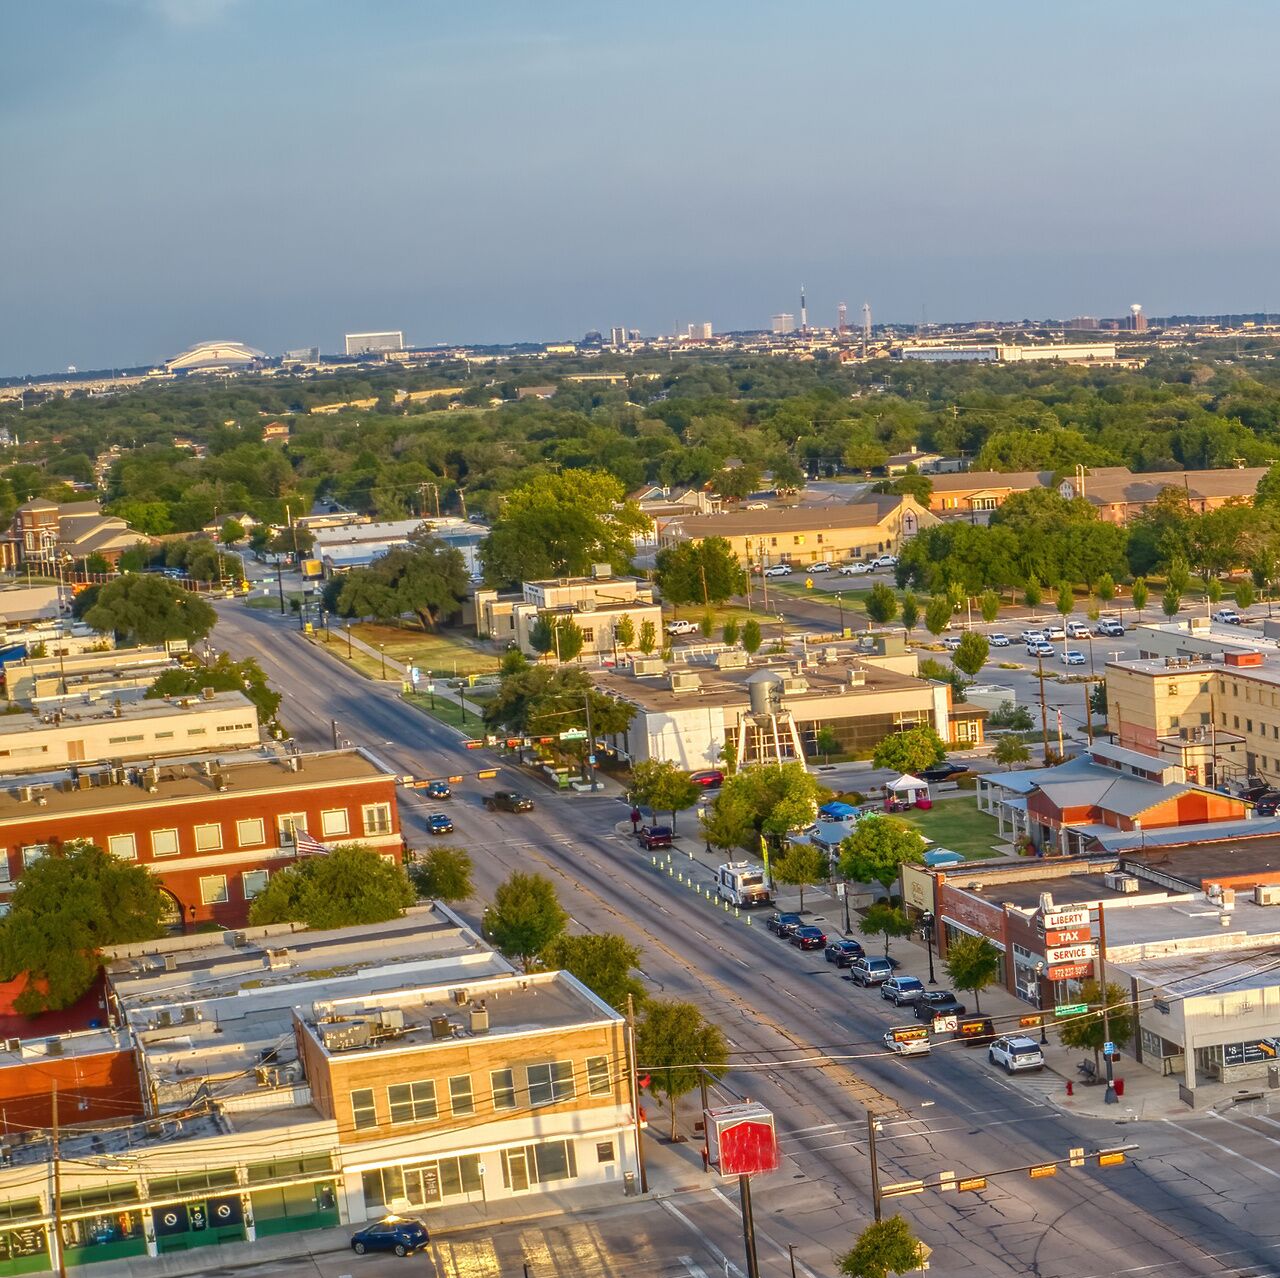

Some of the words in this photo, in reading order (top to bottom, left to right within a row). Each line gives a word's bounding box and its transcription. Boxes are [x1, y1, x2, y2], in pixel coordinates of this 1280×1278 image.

[1051, 913, 1083, 925] LIBERTY
[1058, 931, 1079, 942] TAX
[1053, 948, 1087, 960] SERVICE
